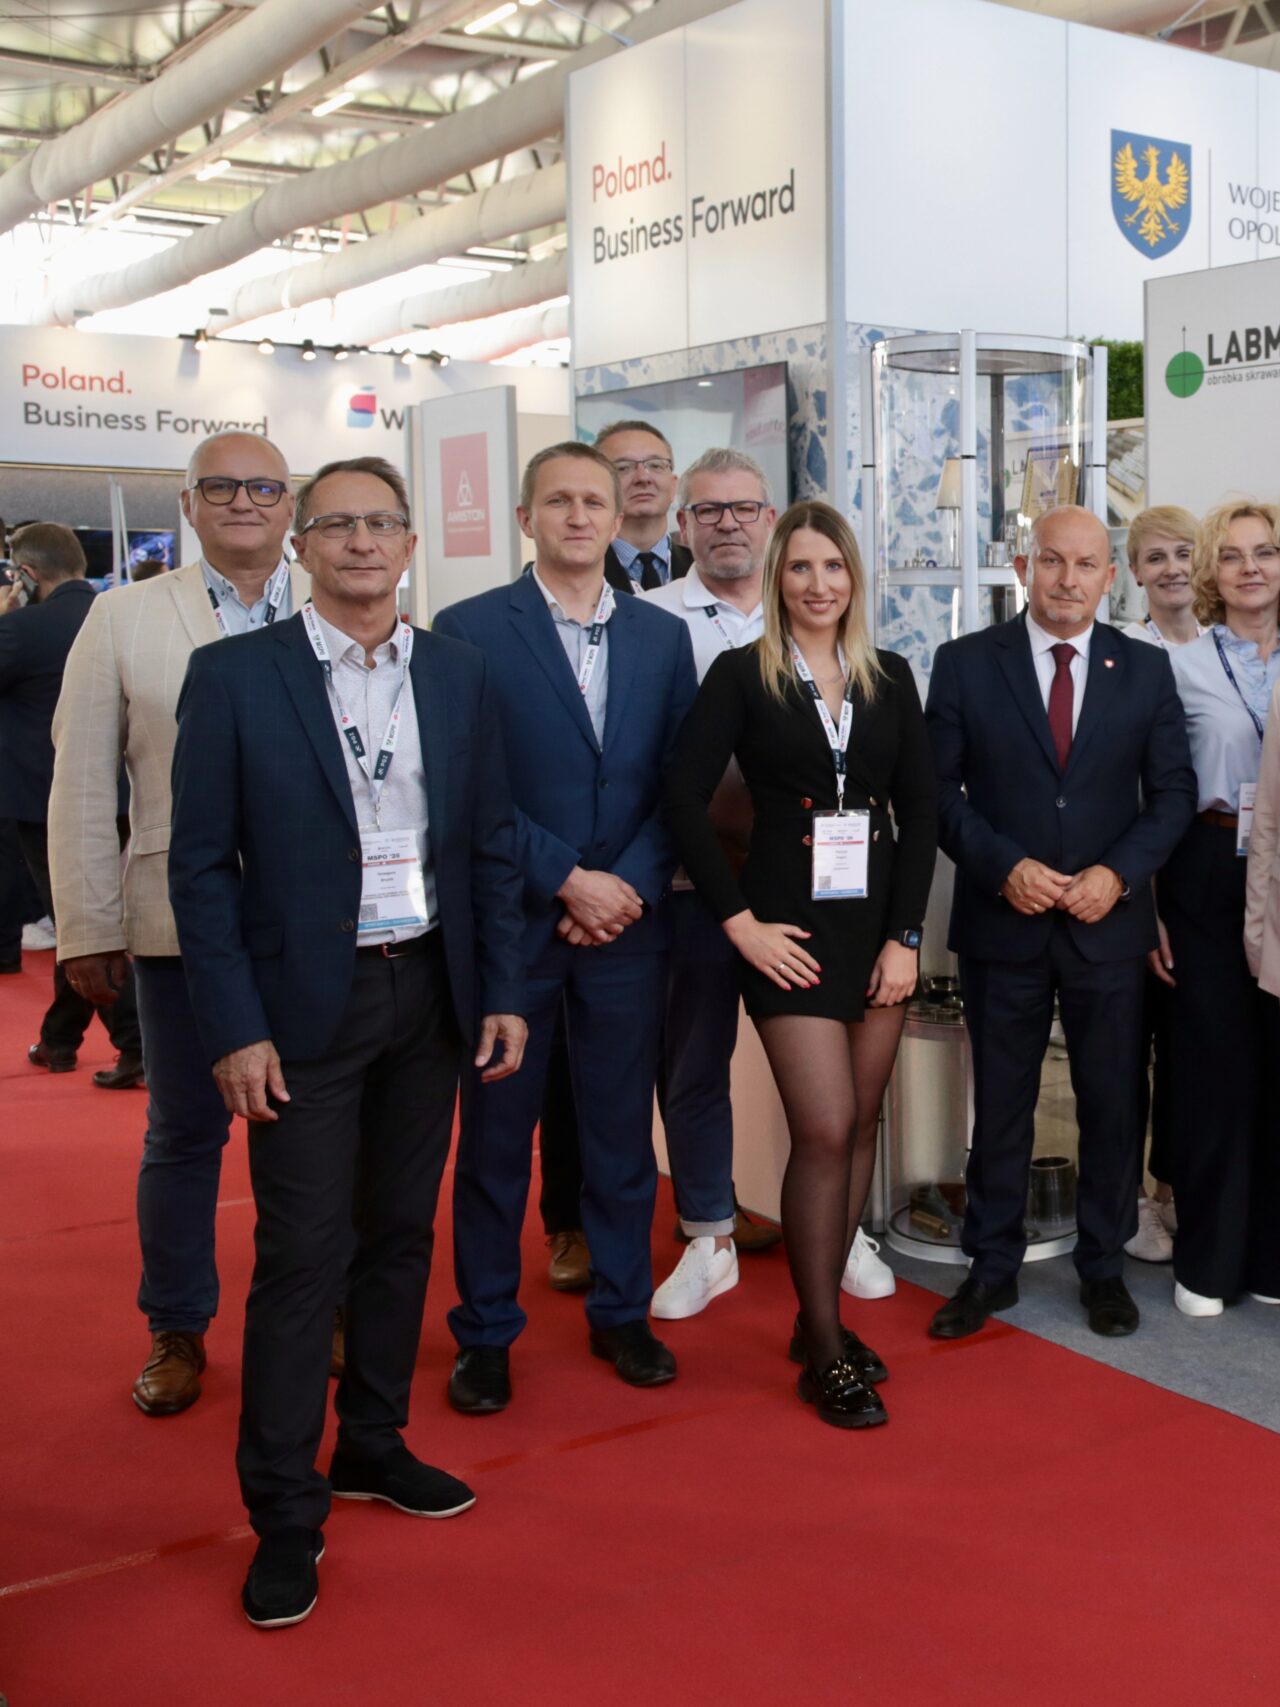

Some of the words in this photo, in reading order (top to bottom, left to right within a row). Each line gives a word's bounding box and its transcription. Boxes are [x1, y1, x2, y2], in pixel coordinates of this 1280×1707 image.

[592, 141, 672, 203] Poland.
[593, 214, 684, 265] Business
[691, 168, 795, 238] Forward
[22, 364, 133, 394] Poland.
[23, 401, 147, 431] Business
[156, 410, 269, 437] Forward
